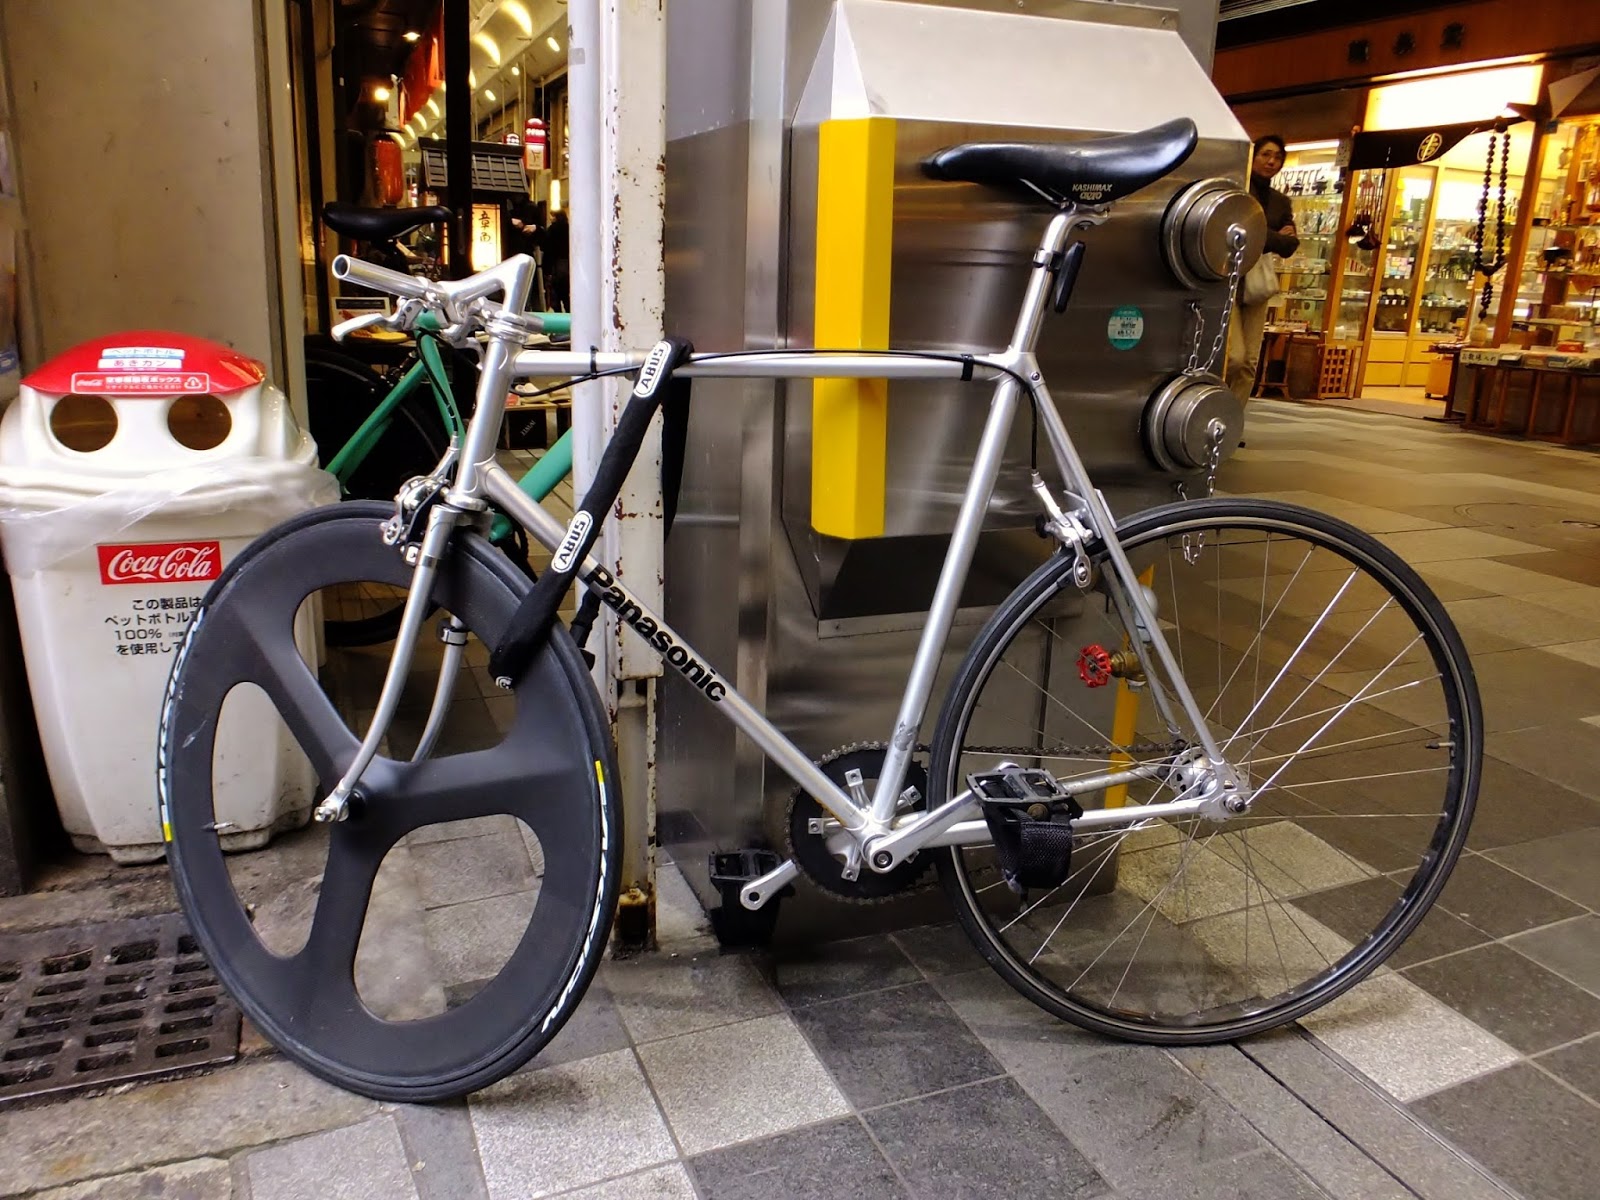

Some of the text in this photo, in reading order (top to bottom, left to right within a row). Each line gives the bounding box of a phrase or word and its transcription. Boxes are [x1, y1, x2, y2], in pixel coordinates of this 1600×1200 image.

[1072, 183, 1113, 192] KASHIMAX
[641, 348, 665, 390] ABUS
[558, 520, 587, 565] ABUS
[107, 546, 217, 581] Coca-Cola
[132, 596, 202, 611] この製品は
[104, 611, 197, 627] ペットボトル
[115, 628, 162, 641] 100%
[584, 564, 727, 702] Panasonic
